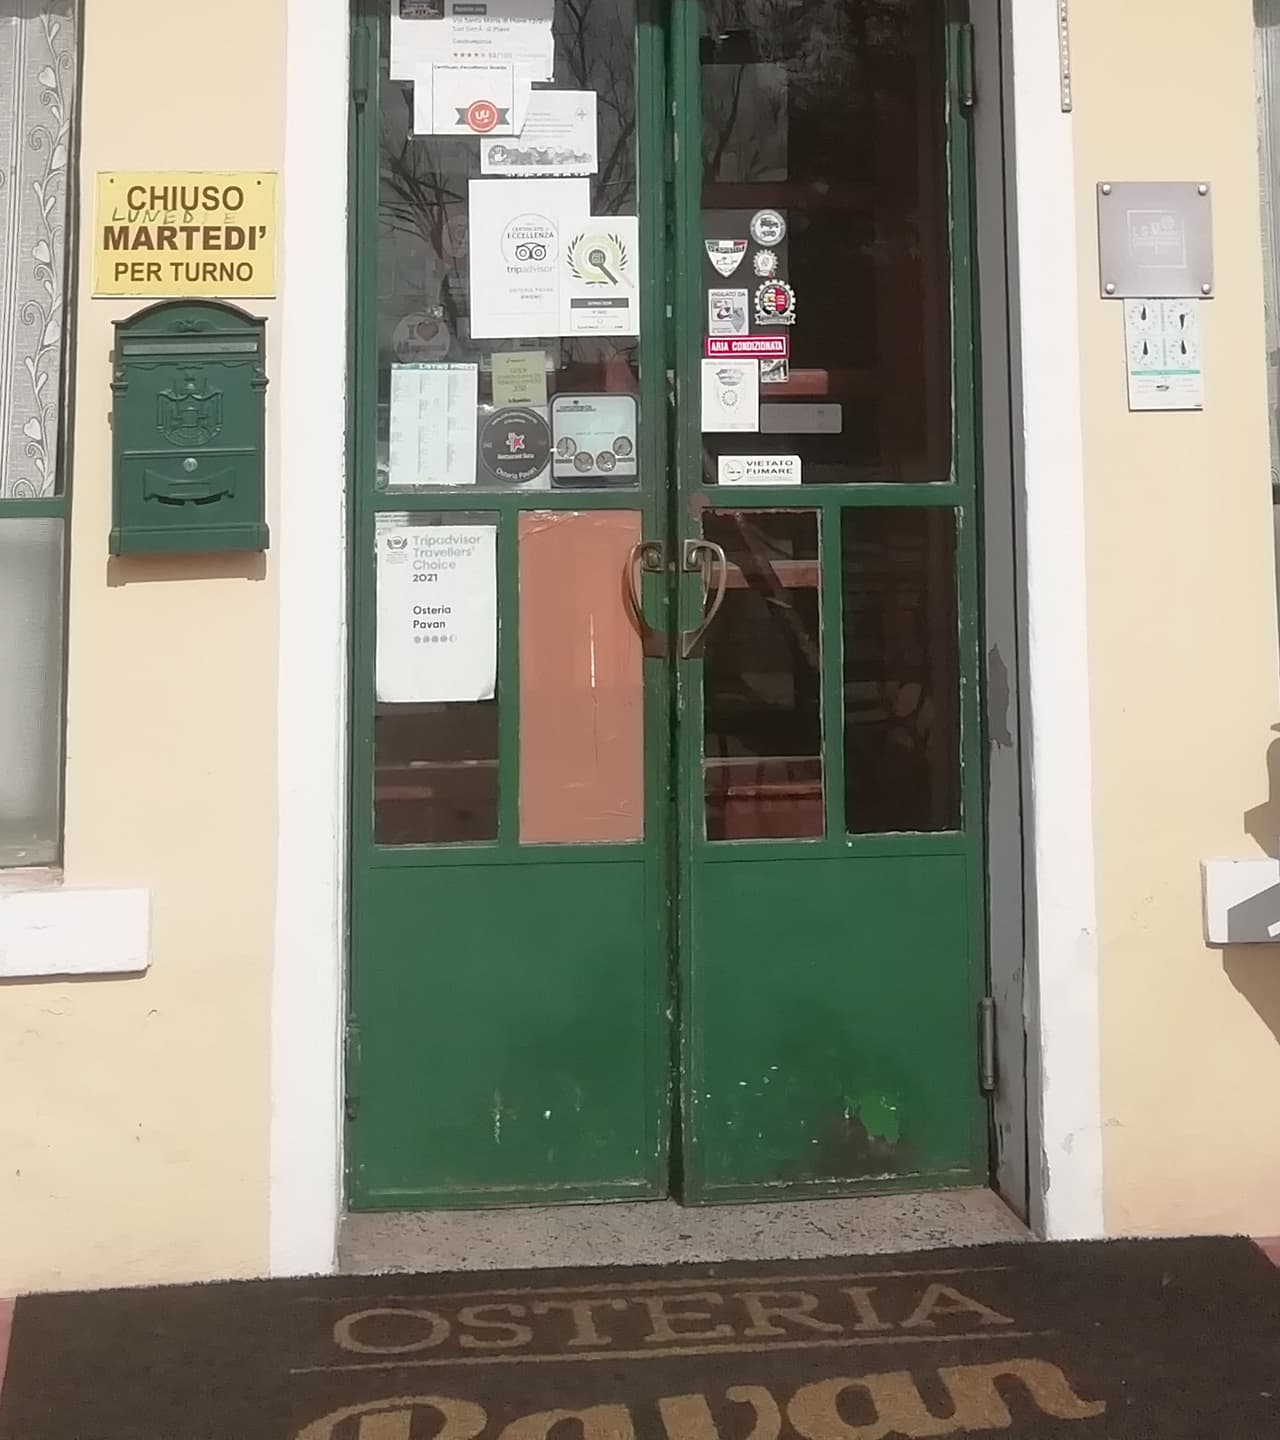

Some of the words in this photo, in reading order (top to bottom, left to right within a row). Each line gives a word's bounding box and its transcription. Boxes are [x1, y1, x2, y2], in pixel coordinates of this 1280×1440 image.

[127, 185, 244, 211] CHIUSO
[114, 262, 162, 282] PER
[169, 262, 253, 282] TURNO
[711, 342, 729, 351] ARIA
[731, 341, 783, 351] CONDIZIONATA
[413, 535, 481, 547] Tripadvisor
[413, 547, 475, 559] Travellers'
[413, 559, 456, 571] Choice
[412, 573, 438, 582] 2021
[413, 605, 451, 615] Osteria
[413, 620, 446, 629] Pavan
[333, 1282, 1016, 1354] OSTERIA
